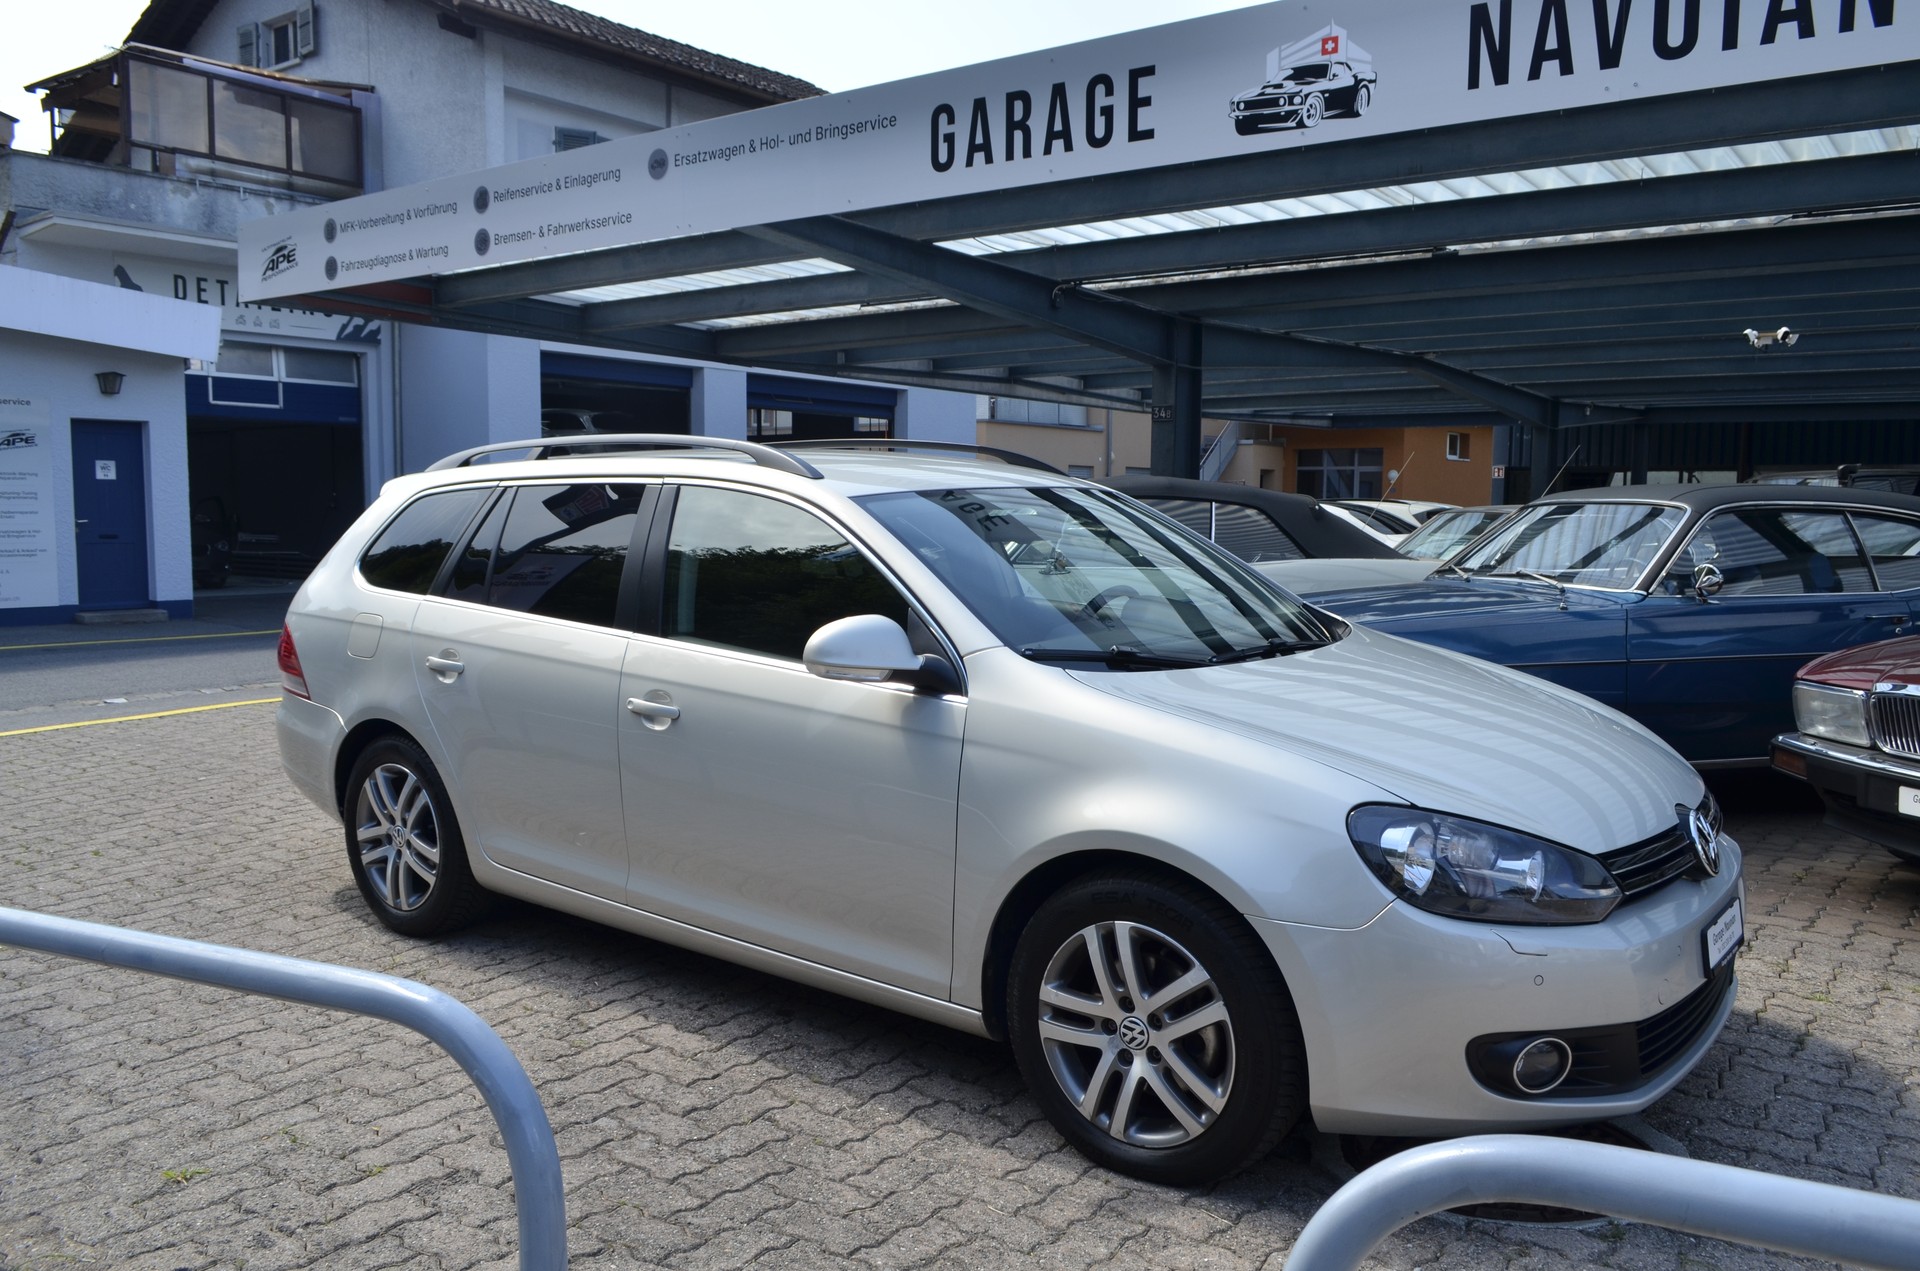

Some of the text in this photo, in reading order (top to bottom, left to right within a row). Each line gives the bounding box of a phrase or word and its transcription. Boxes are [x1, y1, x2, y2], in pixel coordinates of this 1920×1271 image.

[929, 64, 1156, 173] GARAGE
[674, 113, 898, 168] Ersatzwagen & Hol- und Bringservice
[493, 167, 621, 204] Reifenservice & Einlagerung
[340, 201, 458, 234] MFK-Vorbereitung & Vorführung
[494, 211, 633, 246] Bremsen- & Fahrwerksservice
[262, 247, 297, 277] APE
[341, 244, 449, 273] Fahrzeugdiagnose & Wartung
